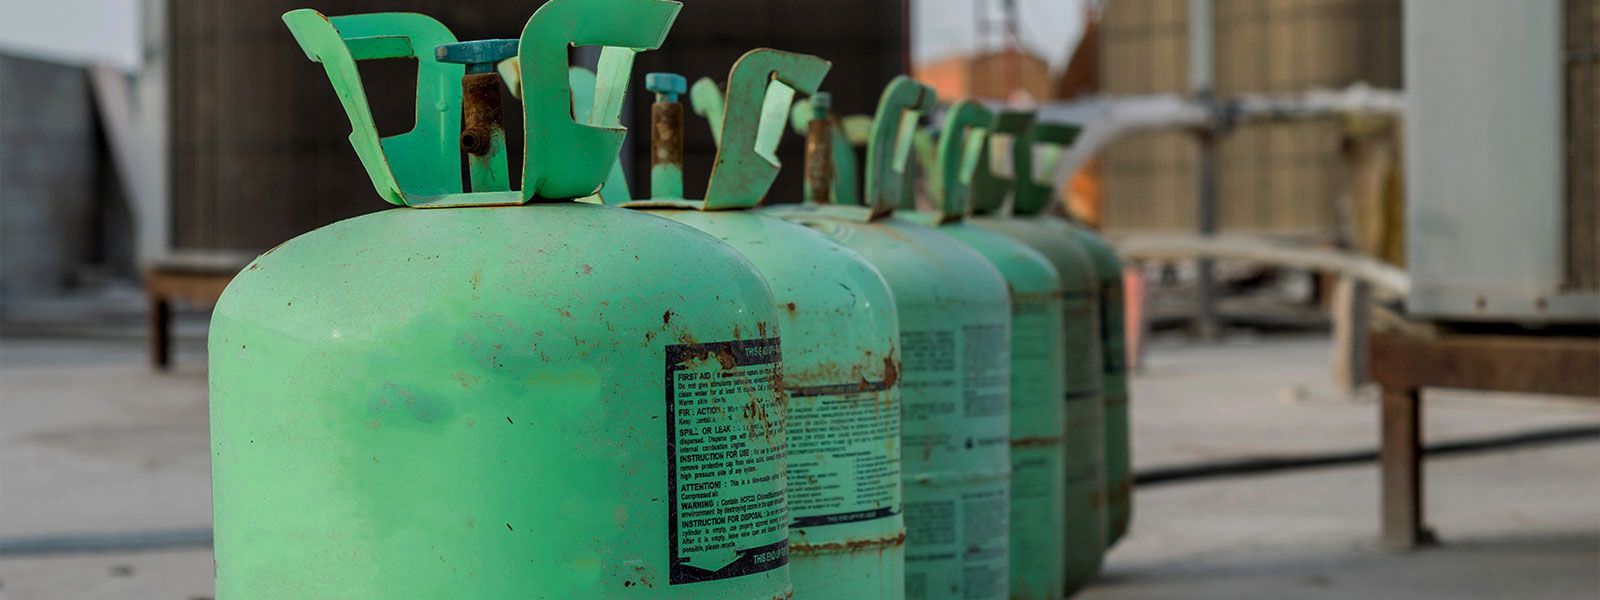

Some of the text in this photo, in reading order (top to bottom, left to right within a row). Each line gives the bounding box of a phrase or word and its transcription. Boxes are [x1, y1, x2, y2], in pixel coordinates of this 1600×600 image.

[678, 372, 697, 381] FIRST
[700, 371, 710, 379] AID
[698, 381, 708, 389] give
[697, 397, 708, 405] skin
[678, 407, 695, 417] FIR
[702, 426, 712, 435] OR
[714, 424, 731, 434] LEAK
[702, 443, 727, 452] combustion
[680, 451, 724, 463] INSTRUCTION
[726, 450, 738, 459] FOR
[740, 448, 750, 457] USE
[680, 464, 698, 472] remove
[701, 462, 724, 470] protective
[725, 460, 734, 469] cap
[680, 472, 692, 481] high
[694, 470, 715, 479] pressure
[681, 480, 721, 492] ATTENTION!
[730, 479, 739, 487] This
[681, 492, 712, 501] Compressed
[682, 500, 714, 510] WARNING
[682, 516, 726, 529] INSTRUCTION
[727, 514, 740, 523] FOR
[741, 510, 763, 521] DISPOSAL
[682, 529, 702, 538] cylinder
[705, 542, 720, 552] please
[753, 552, 766, 564] THIS
